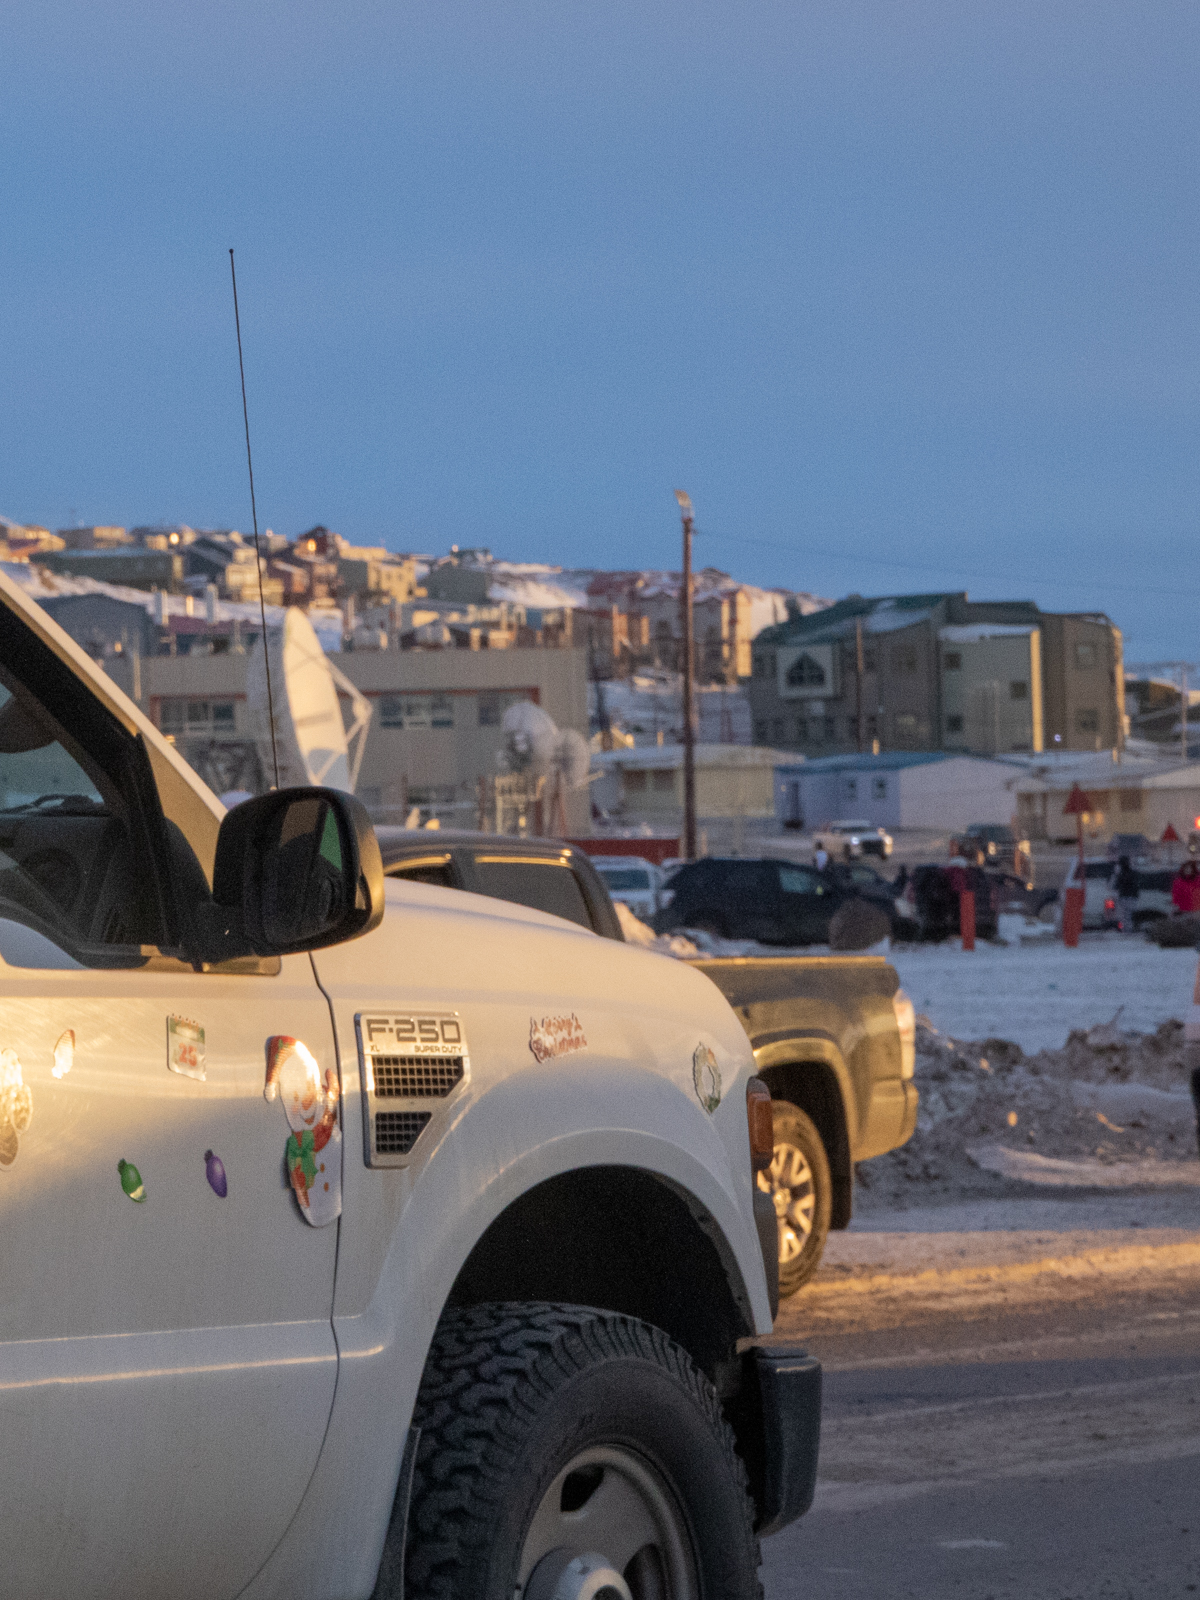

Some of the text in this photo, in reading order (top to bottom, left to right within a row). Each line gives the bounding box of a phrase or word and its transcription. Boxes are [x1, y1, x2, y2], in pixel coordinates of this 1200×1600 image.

[178, 1042, 197, 1067] 25
[414, 1045, 462, 1054] SUPER DUTY
